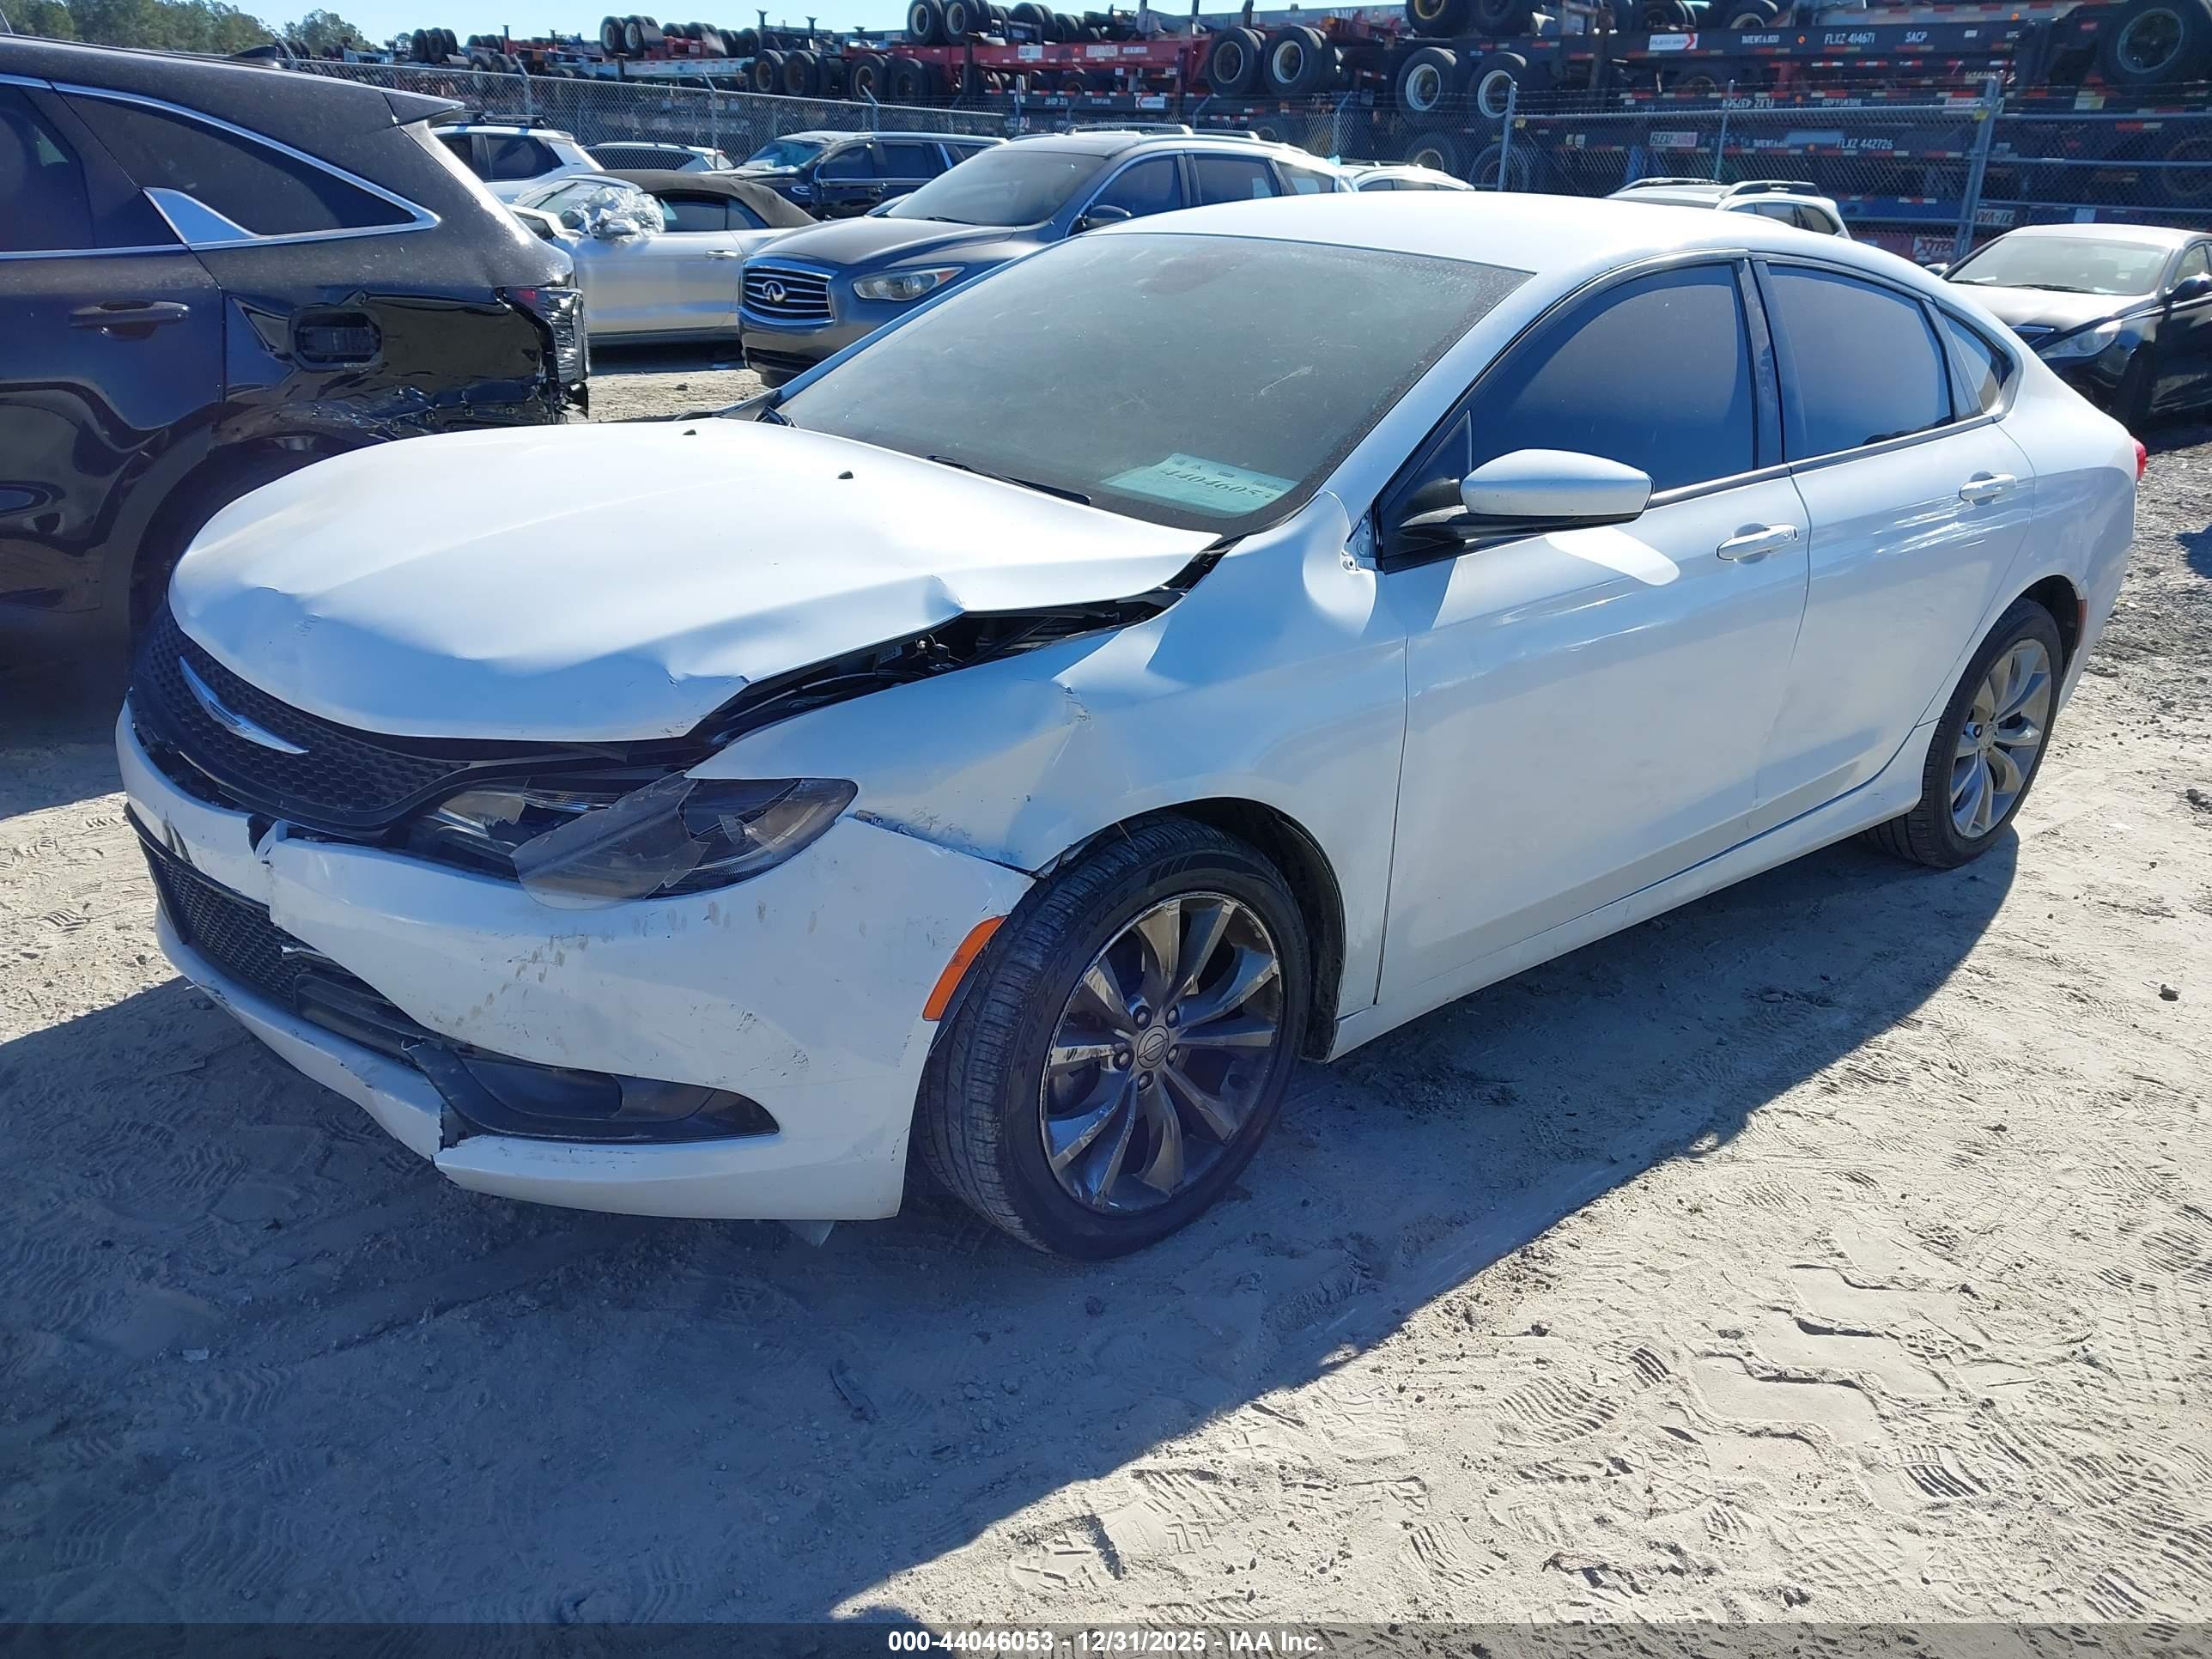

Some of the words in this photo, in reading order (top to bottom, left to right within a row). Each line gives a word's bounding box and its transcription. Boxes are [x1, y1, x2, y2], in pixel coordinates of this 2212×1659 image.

[1825, 33, 1846, 44] FLXZ
[1848, 32, 1875, 44] 414671
[1905, 32, 1928, 43] SACP
[1836, 138, 1858, 149] FLXZ
